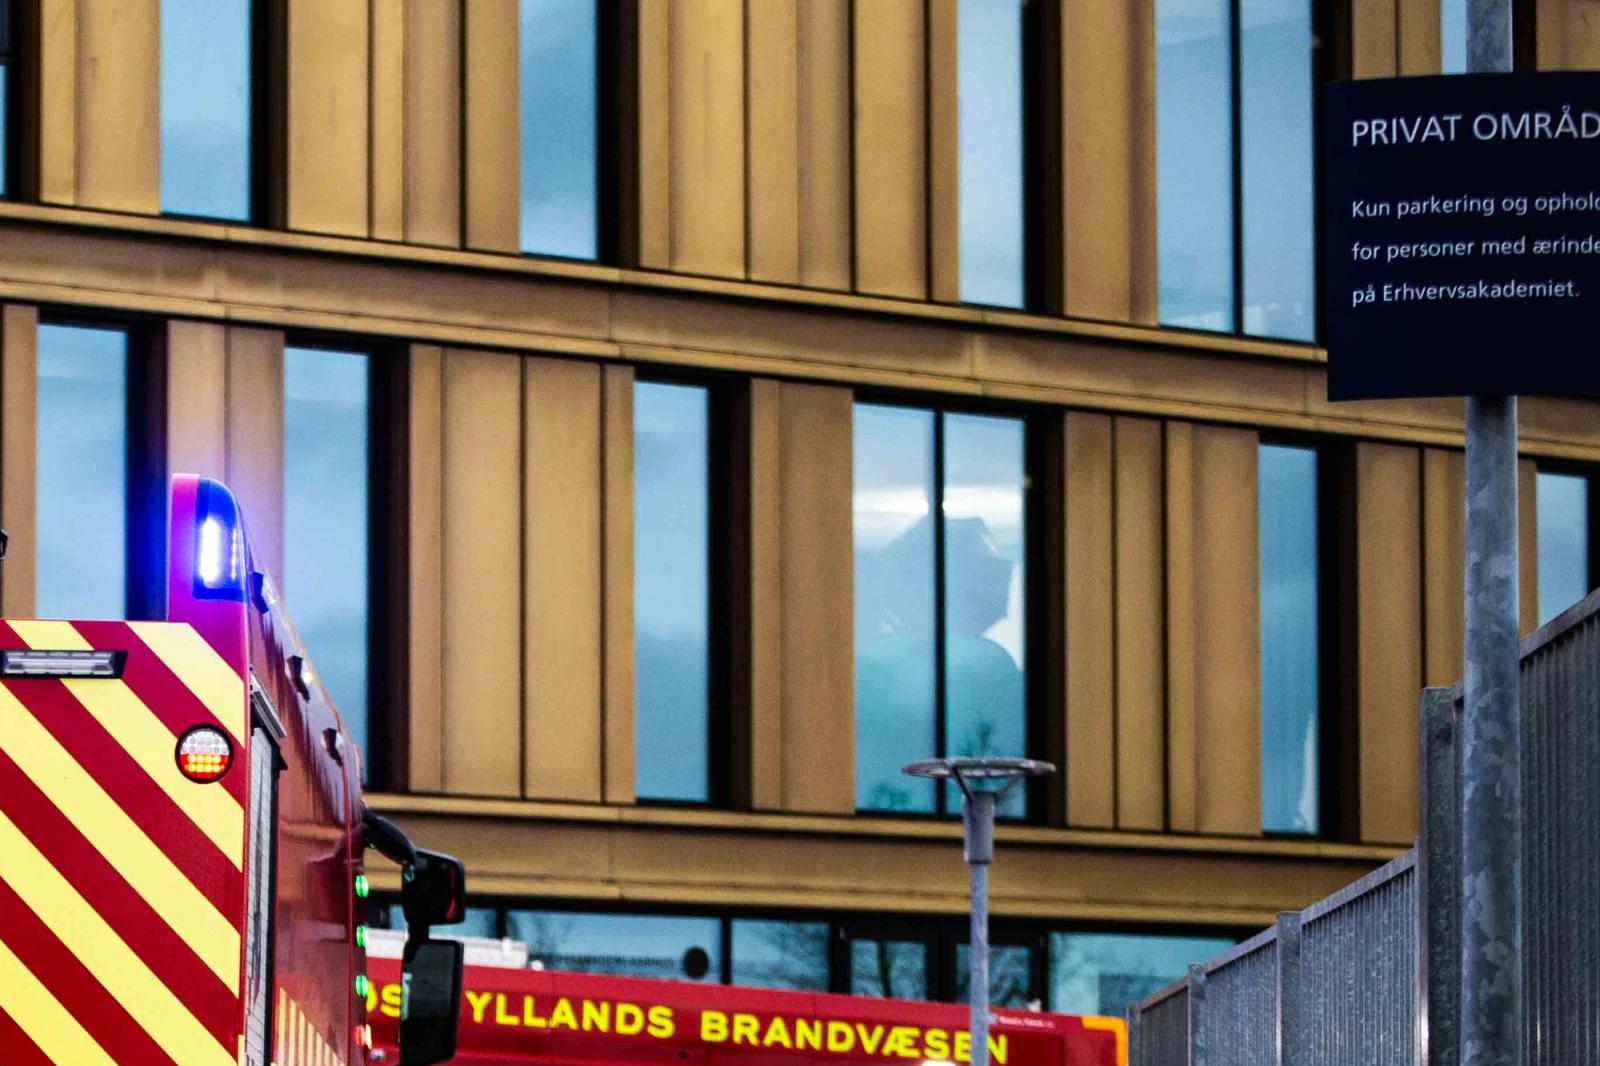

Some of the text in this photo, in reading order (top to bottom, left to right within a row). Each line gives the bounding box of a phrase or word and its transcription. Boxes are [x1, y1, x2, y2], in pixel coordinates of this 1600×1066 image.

[1352, 104, 1600, 146] PRIVAT OMRÅD
[1352, 200, 1390, 218] Kun
[1397, 194, 1495, 219] parkering
[1502, 195, 1528, 215] og
[1352, 242, 1380, 261] for
[1387, 239, 1475, 262] personer
[1482, 236, 1525, 255] med
[1352, 279, 1580, 307] på Erhvervsakademiet.
[366, 977, 1008, 1065] SYLLANDS BRANDVÆSEN
